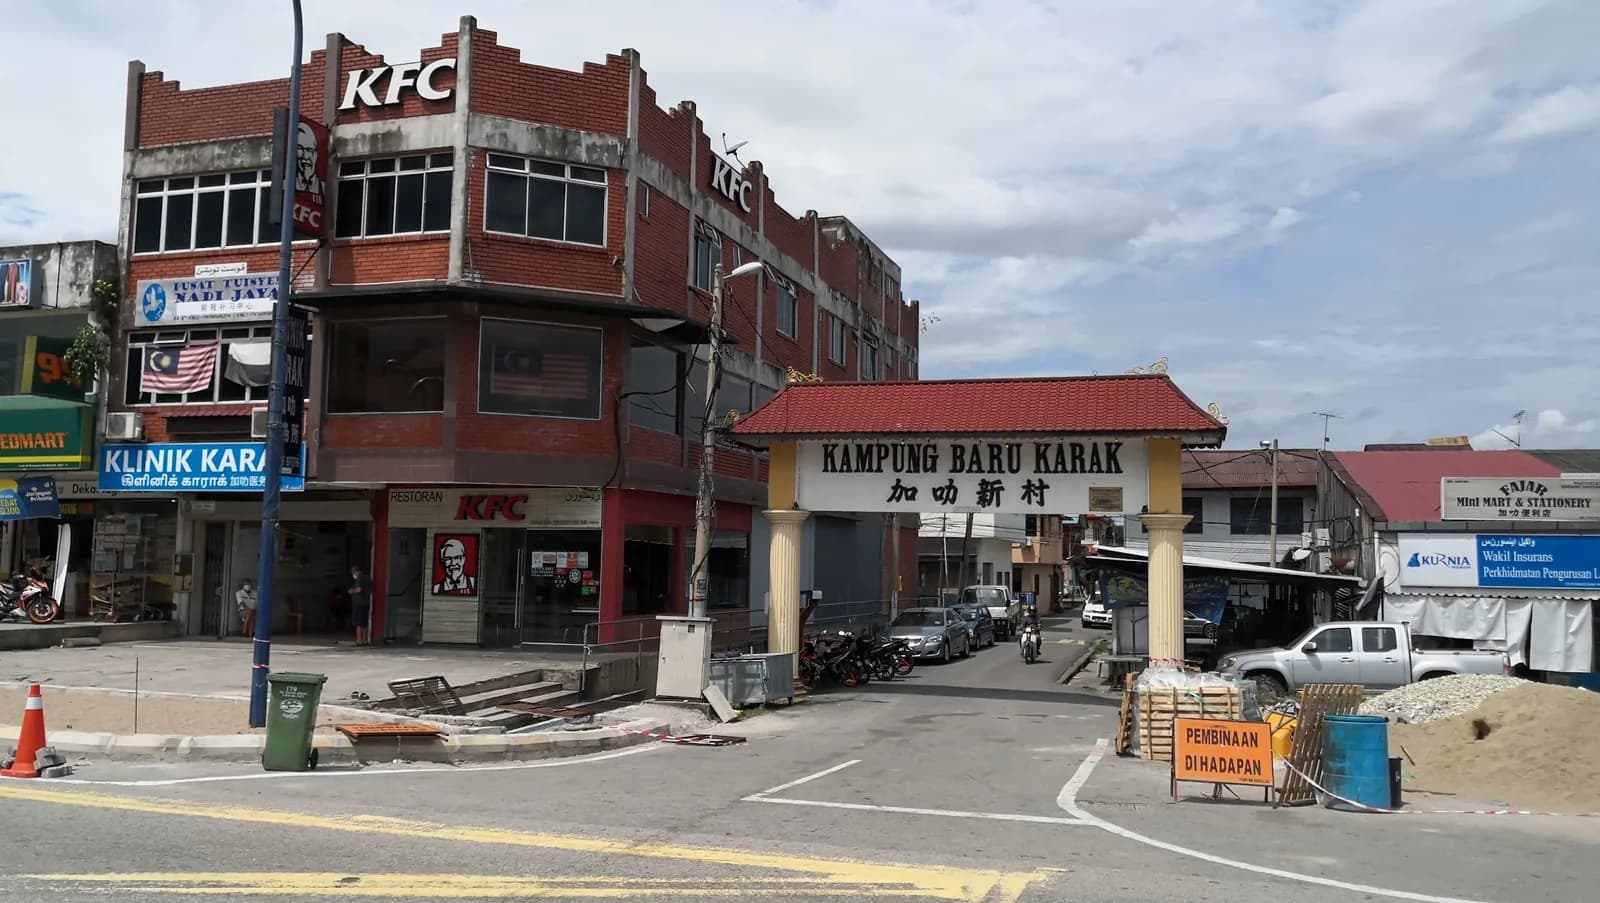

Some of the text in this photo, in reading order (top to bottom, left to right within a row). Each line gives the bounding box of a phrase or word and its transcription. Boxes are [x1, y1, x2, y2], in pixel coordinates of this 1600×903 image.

[338, 58, 458, 110] KFC
[712, 157, 752, 213] KFC
[293, 206, 321, 227] KFC
[174, 280, 214, 291] PUSAT
[176, 287, 279, 303] NADI JAYA
[105, 449, 192, 473] KLINIK
[823, 443, 1123, 474] KAMPUNG BARU KARAK
[887, 479, 1050, 508] 加叻新村
[1497, 480, 1548, 496] FAJAR
[391, 492, 443, 503] RESTORAN
[1483, 497, 1512, 507] MART
[1516, 498, 1524, 507] &
[1527, 497, 1592, 508] STATIONERY
[454, 497, 529, 521] KFC
[1422, 553, 1471, 568] KURNIA
[1483, 551, 1553, 563] Wakil Insurans
[1483, 567, 1541, 579] Perkhidmatan
[1543, 568, 1592, 582] Pengurusan
[1187, 728, 1257, 747] PEMBINAAN
